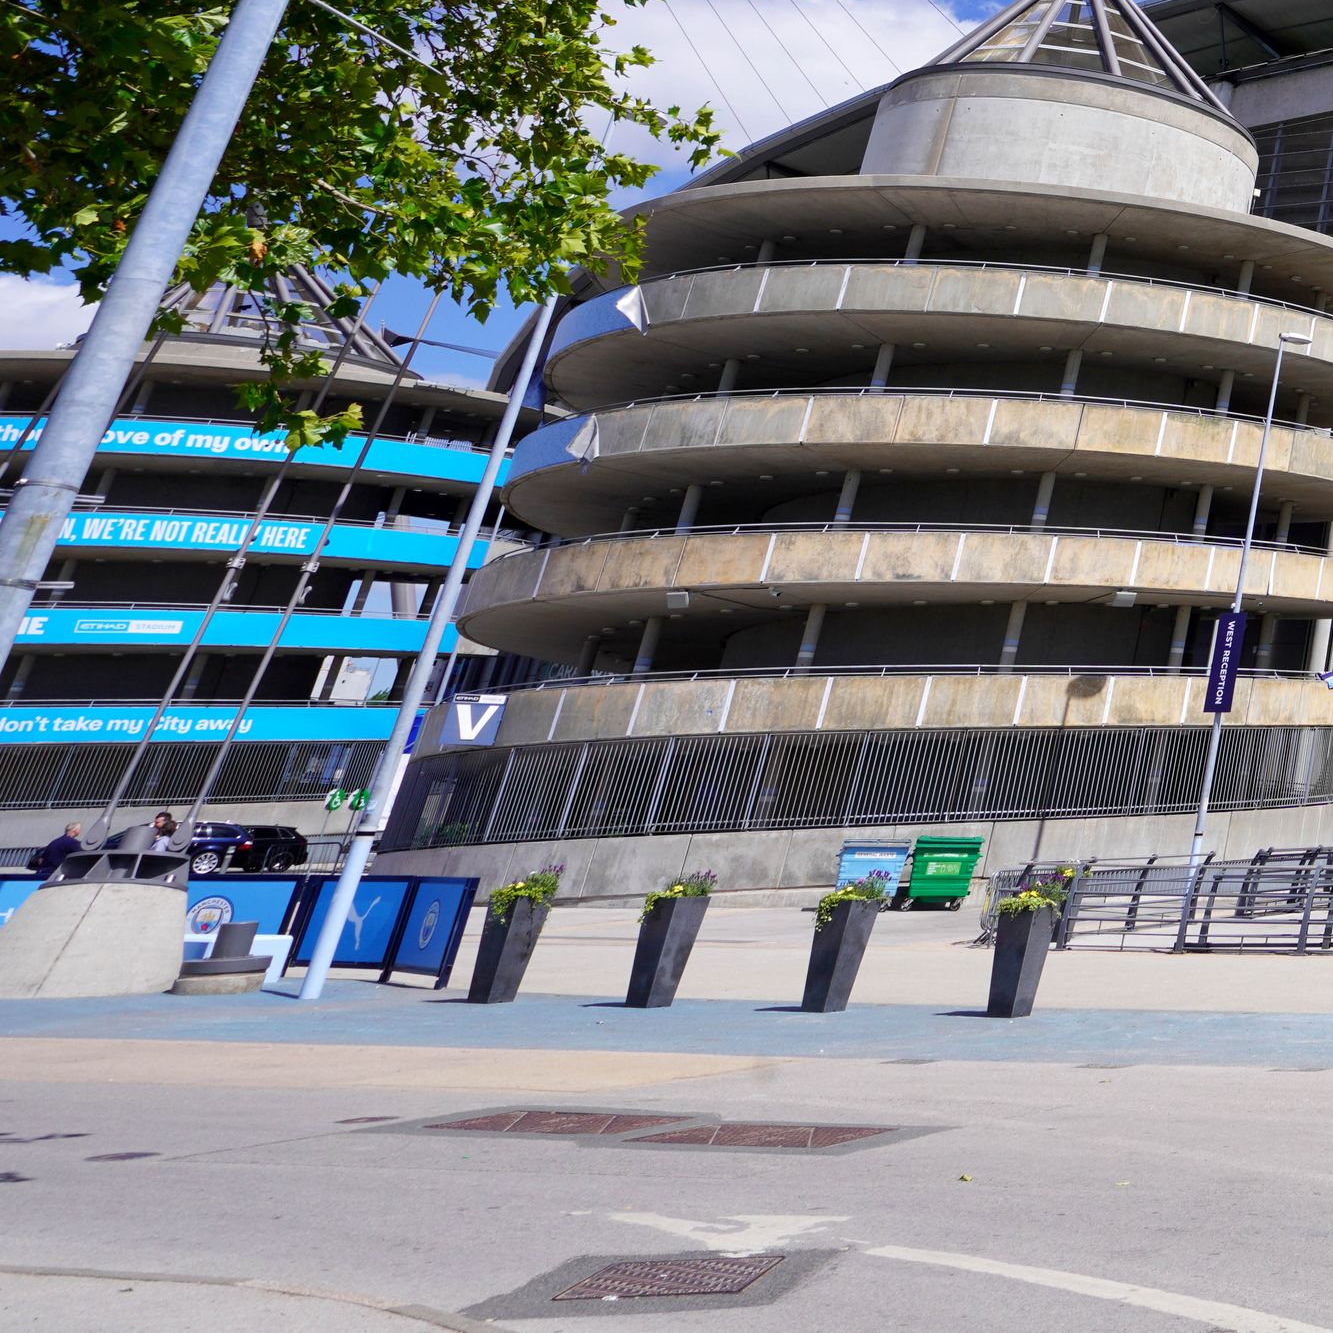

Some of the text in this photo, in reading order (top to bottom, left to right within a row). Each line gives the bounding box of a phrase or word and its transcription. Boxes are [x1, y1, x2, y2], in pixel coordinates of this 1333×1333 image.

[154, 430, 186, 446] of
[186, 434, 230, 453] my
[150, 522, 189, 542] NOT
[261, 526, 310, 548] HERE
[136, 623, 176, 631] STADIUM
[1215, 620, 1236, 705] WEST RECEPTION
[53, 716, 100, 731] take
[107, 720, 143, 734] my
[456, 704, 500, 740] V
